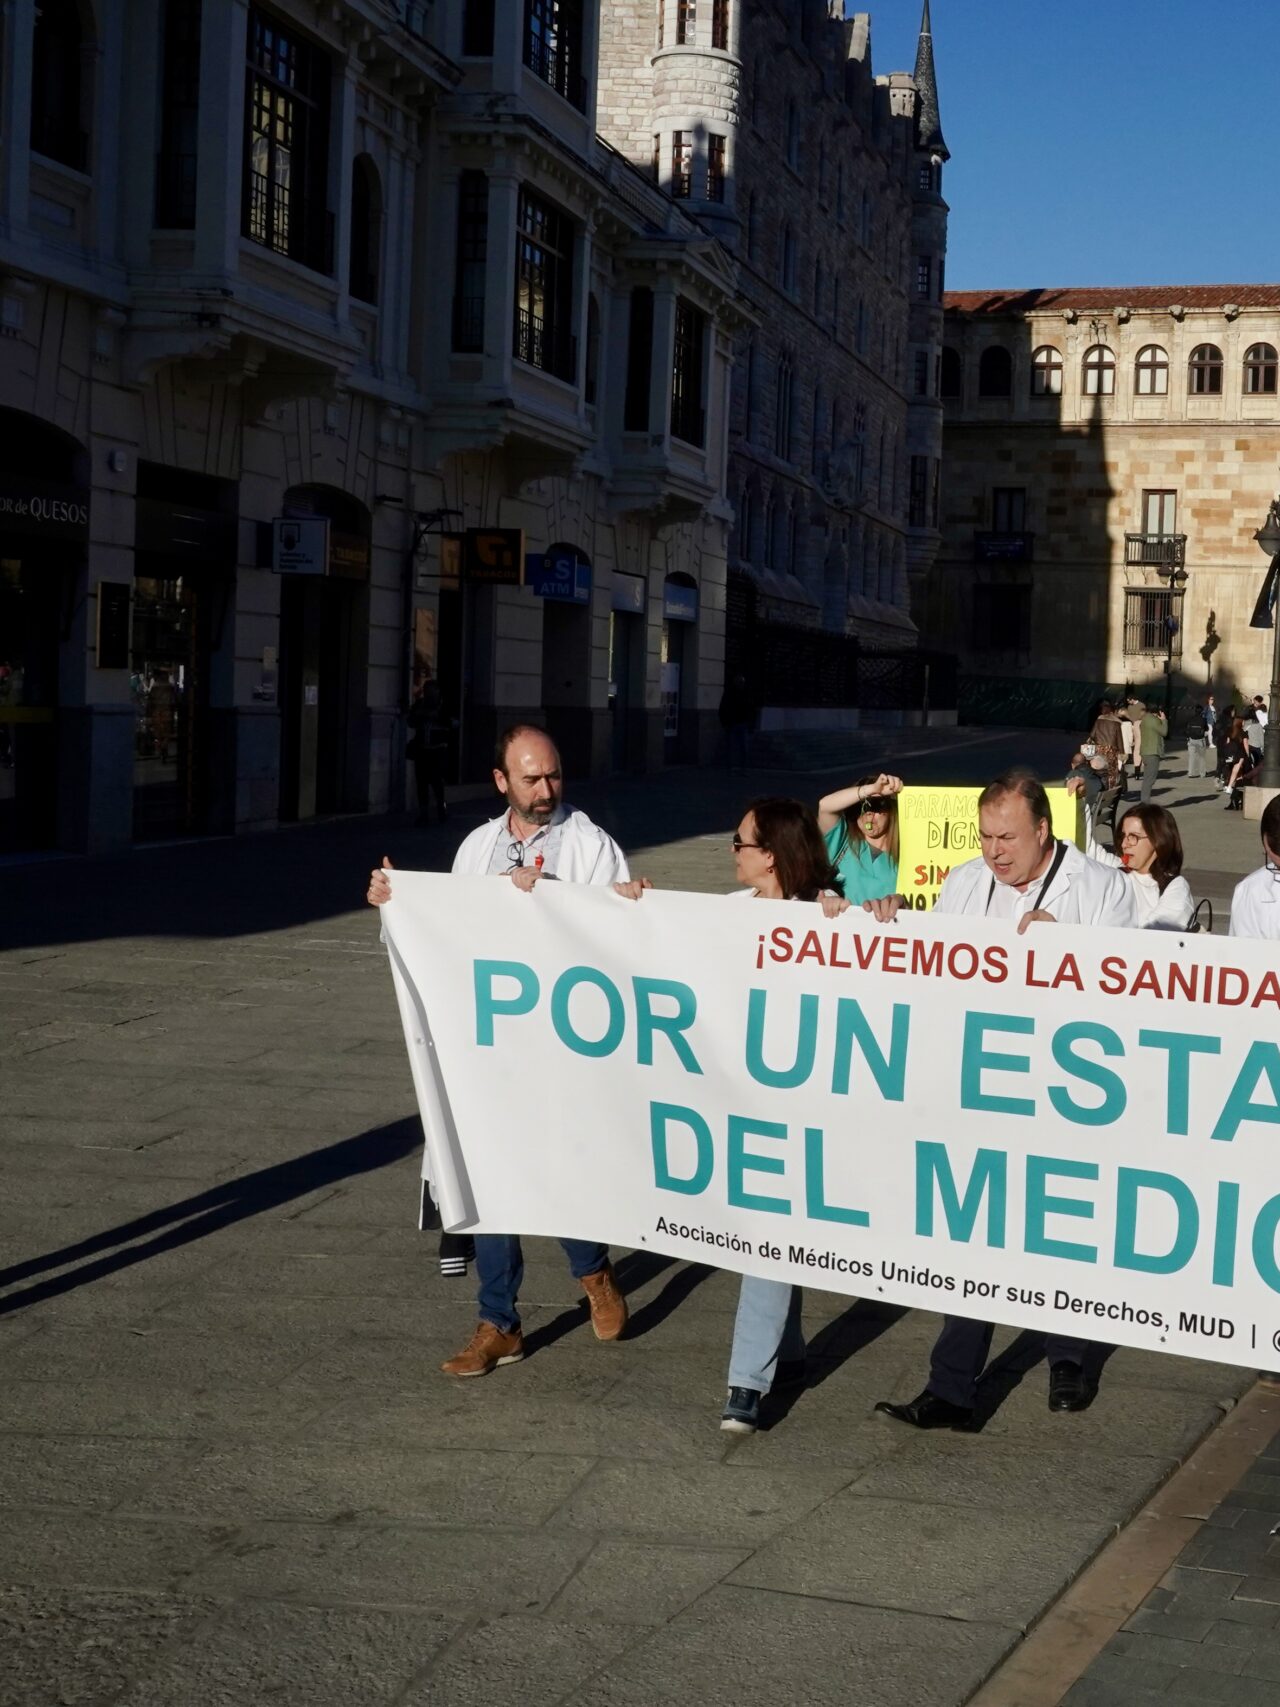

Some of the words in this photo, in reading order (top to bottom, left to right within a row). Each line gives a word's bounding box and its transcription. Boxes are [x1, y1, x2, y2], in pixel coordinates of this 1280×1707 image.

[15, 498, 28, 515] de
[30, 496, 88, 525] QUESOS
[539, 582, 570, 595] ATM
[756, 927, 1008, 983] ¡SALVEMOS
[1025, 950, 1084, 991] LA
[474, 959, 704, 1075] POR
[745, 988, 911, 1102] UN
[650, 1101, 870, 1228] DEL
[655, 1216, 752, 1255] Asociación
[758, 1241, 782, 1261] de
[788, 1245, 874, 1277] Médicos
[881, 1260, 956, 1292] Unidos
[963, 1279, 1001, 1298] por
[1006, 1287, 1046, 1307] sus
[1054, 1289, 1171, 1332] Derechos,
[1178, 1311, 1235, 1339] MUD
